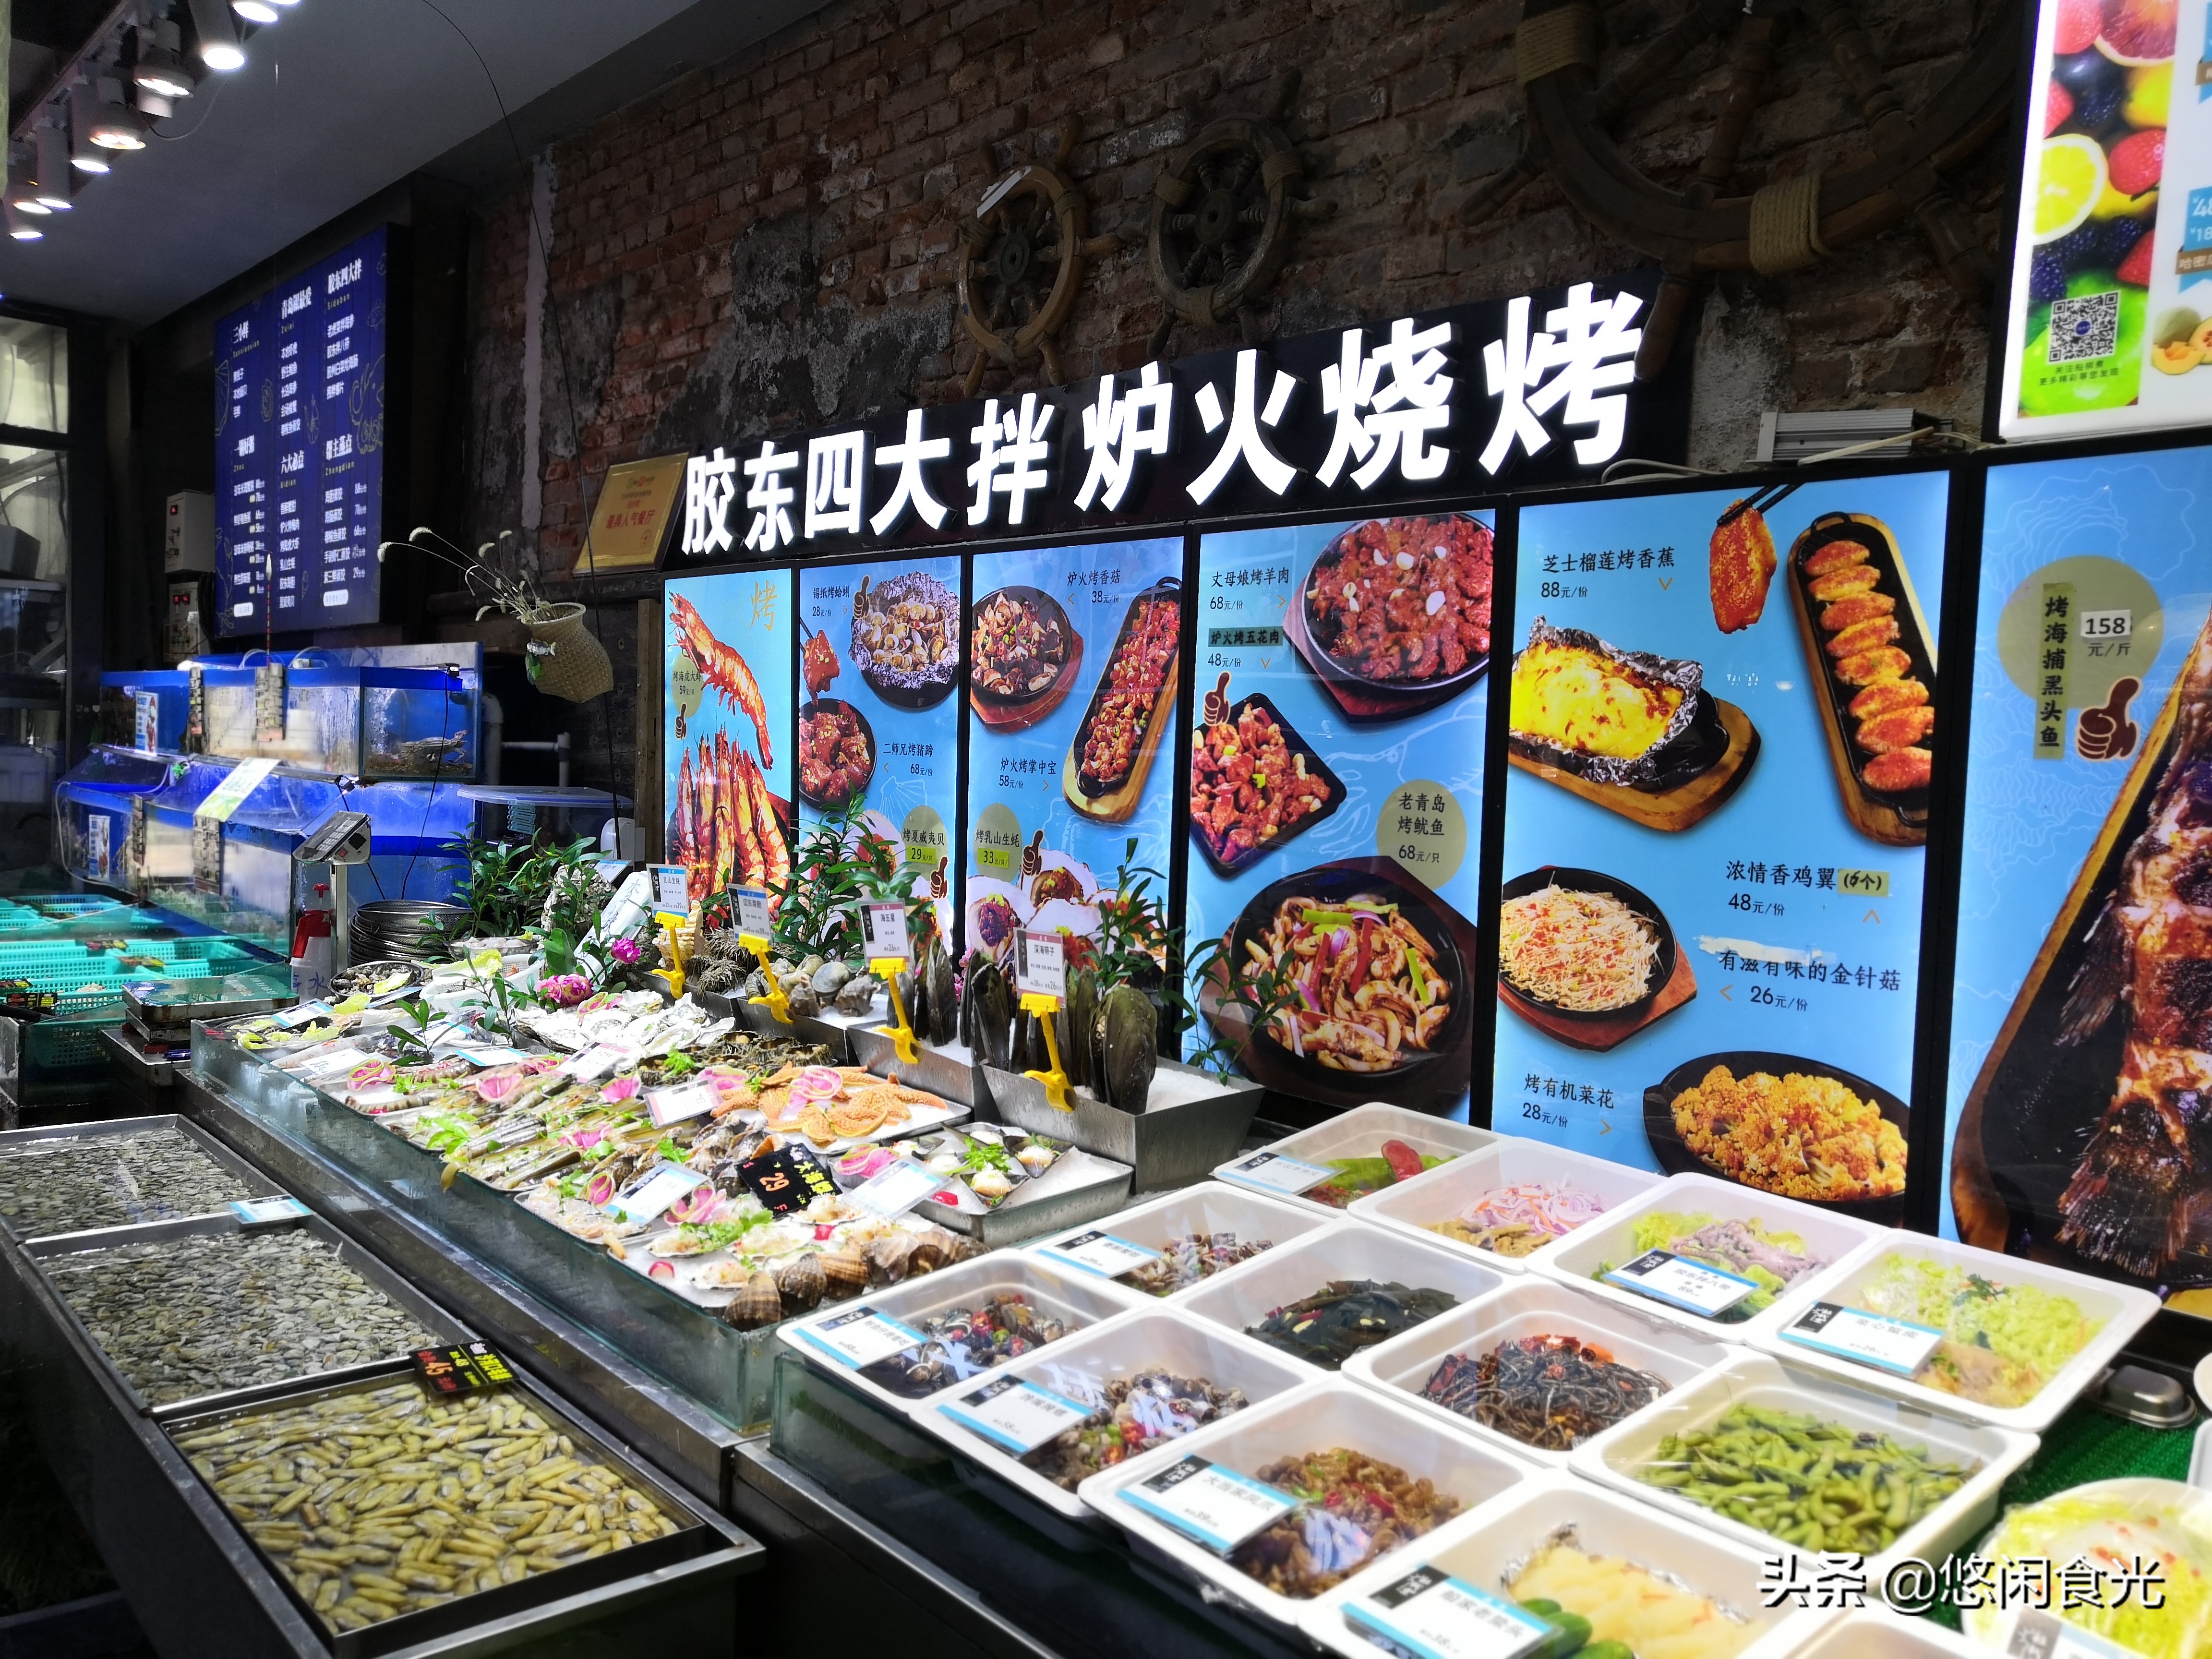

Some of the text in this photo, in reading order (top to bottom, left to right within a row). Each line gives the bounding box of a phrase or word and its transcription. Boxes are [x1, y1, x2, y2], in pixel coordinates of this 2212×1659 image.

[328, 258, 361, 293] 胶东四大拌
[327, 293, 349, 310] Sidaban
[326, 433, 351, 460] 帮主蒸点
[281, 450, 304, 473] 六大必点
[325, 461, 354, 475] Zhengdian
[1543, 546, 1675, 573] 芝士榴莲烤香蕉
[1067, 569, 1120, 587] 炉火烤香菇
[1211, 567, 1289, 587] 丈母娘烤羊肉
[813, 586, 850, 599] 锡纸烤蛤蜊
[1092, 591, 1119, 603] 38元/份
[1541, 581, 1588, 598] 88元/份
[750, 579, 778, 631] 烤
[812, 606, 832, 617] 28元/份
[1210, 596, 1243, 610] 68元/份
[2085, 617, 2126, 635] 158
[1211, 629, 1279, 645] 炉火烤五花肉
[2087, 643, 2131, 657] 元/斤
[1208, 653, 1241, 667] 48元/份
[673, 670, 702, 682] 烤海虎大虾
[2039, 596, 2069, 747] 烤海捕黑头鱼
[679, 685, 695, 696] 59元/只
[883, 743, 933, 757] 二师兄烤猪蹄
[911, 764, 933, 776] 68元/份
[1001, 757, 1057, 774] 炉火烤掌中宝
[999, 775, 1023, 789] 58元/份
[1399, 792, 1445, 813] 老青岛
[1397, 816, 1445, 835] 烤鱿鱼
[902, 829, 944, 846] 烤夏威夷贝
[975, 830, 1019, 848] 烤乳山生蚝
[911, 848, 932, 862] 29元/只
[1399, 845, 1440, 863] 68元/只
[1726, 860, 1836, 890] 浓情香鸡翼
[1729, 893, 1785, 916] 48元/份
[1034, 944, 1055, 957] 深海带子
[1719, 950, 1901, 991] 有滋有味的金针菇
[1751, 986, 1808, 1011] 26元/份
[1524, 1073, 1614, 1109] 烤有机菜花
[1523, 1102, 1568, 1128] 28元/份
[759, 1172, 789, 1191] 29
